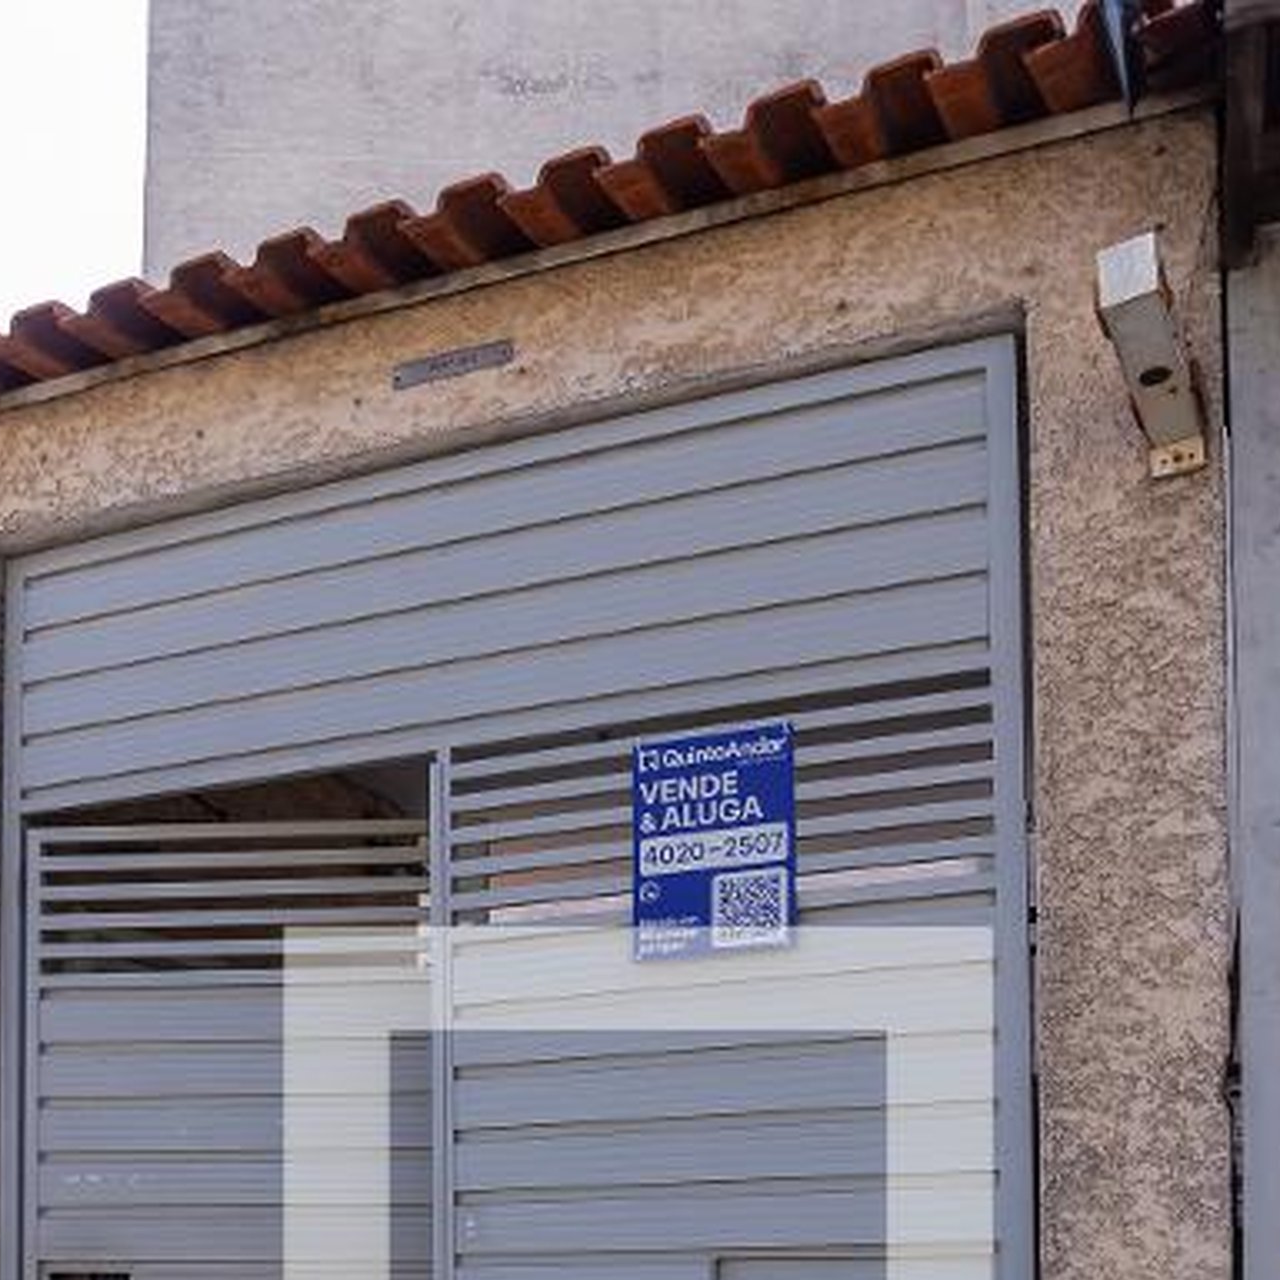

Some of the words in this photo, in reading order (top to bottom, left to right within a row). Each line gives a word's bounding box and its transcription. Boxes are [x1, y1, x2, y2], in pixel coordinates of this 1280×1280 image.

[663, 737, 787, 767] QuintoAndar
[639, 772, 738, 804] VENDE
[661, 797, 764, 830] ALUGA
[644, 833, 784, 866] 4020-2507
